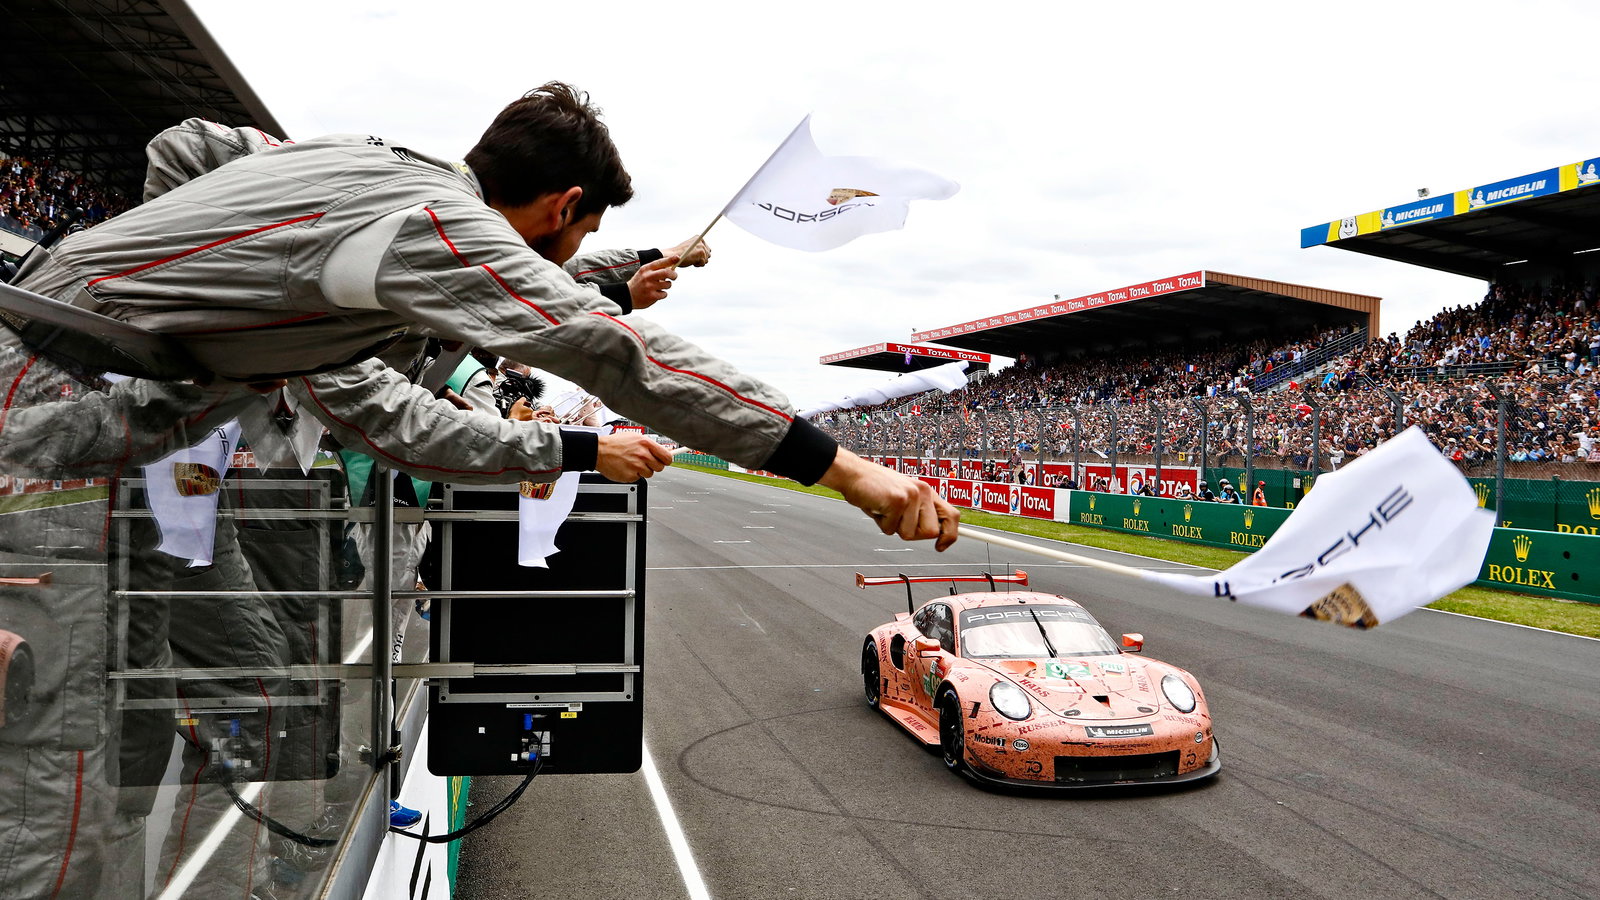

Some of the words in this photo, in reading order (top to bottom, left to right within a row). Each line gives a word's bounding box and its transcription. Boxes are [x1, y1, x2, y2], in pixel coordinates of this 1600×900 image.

[1486, 179, 1546, 201] MICHELIN
[1395, 203, 1444, 222] MICHELIN
[953, 326, 963, 334] TOTAL
[965, 324, 976, 332] TOTAL
[976, 321, 988, 329] TOTAL
[990, 318, 1002, 326] TOTAL
[1004, 315, 1017, 323] TOTAL
[1018, 312, 1032, 320] TOTAL
[1034, 308, 1048, 317] TOTAL
[1051, 304, 1066, 314] TOTAL
[1068, 301, 1084, 310] TOTAL
[1087, 296, 1105, 306] TOTAL
[1108, 292, 1127, 301] TOTAL
[1129, 286, 1149, 297] TOTAL
[1152, 281, 1174, 292] TOTAL
[1178, 276, 1201, 288] TOTAL
[896, 345, 921, 354] TOTAL
[926, 348, 952, 358] TOTAL
[957, 351, 982, 361] TOTAL
[904, 463, 917, 475] TOTA
[950, 485, 971, 500] TOTAL
[983, 488, 1008, 505] TOTAL
[1022, 493, 1051, 511] TOTAL
[1081, 512, 1103, 525] ROLEX
[1124, 518, 1149, 532] ROLEX
[1172, 524, 1203, 539] ROLEX
[1230, 531, 1266, 547] ROLEX
[1488, 564, 1556, 589] ROLEX
[967, 610, 1090, 624] PORSCHE
[1019, 679, 1050, 697] HALS
[974, 733, 996, 745] Mobil
